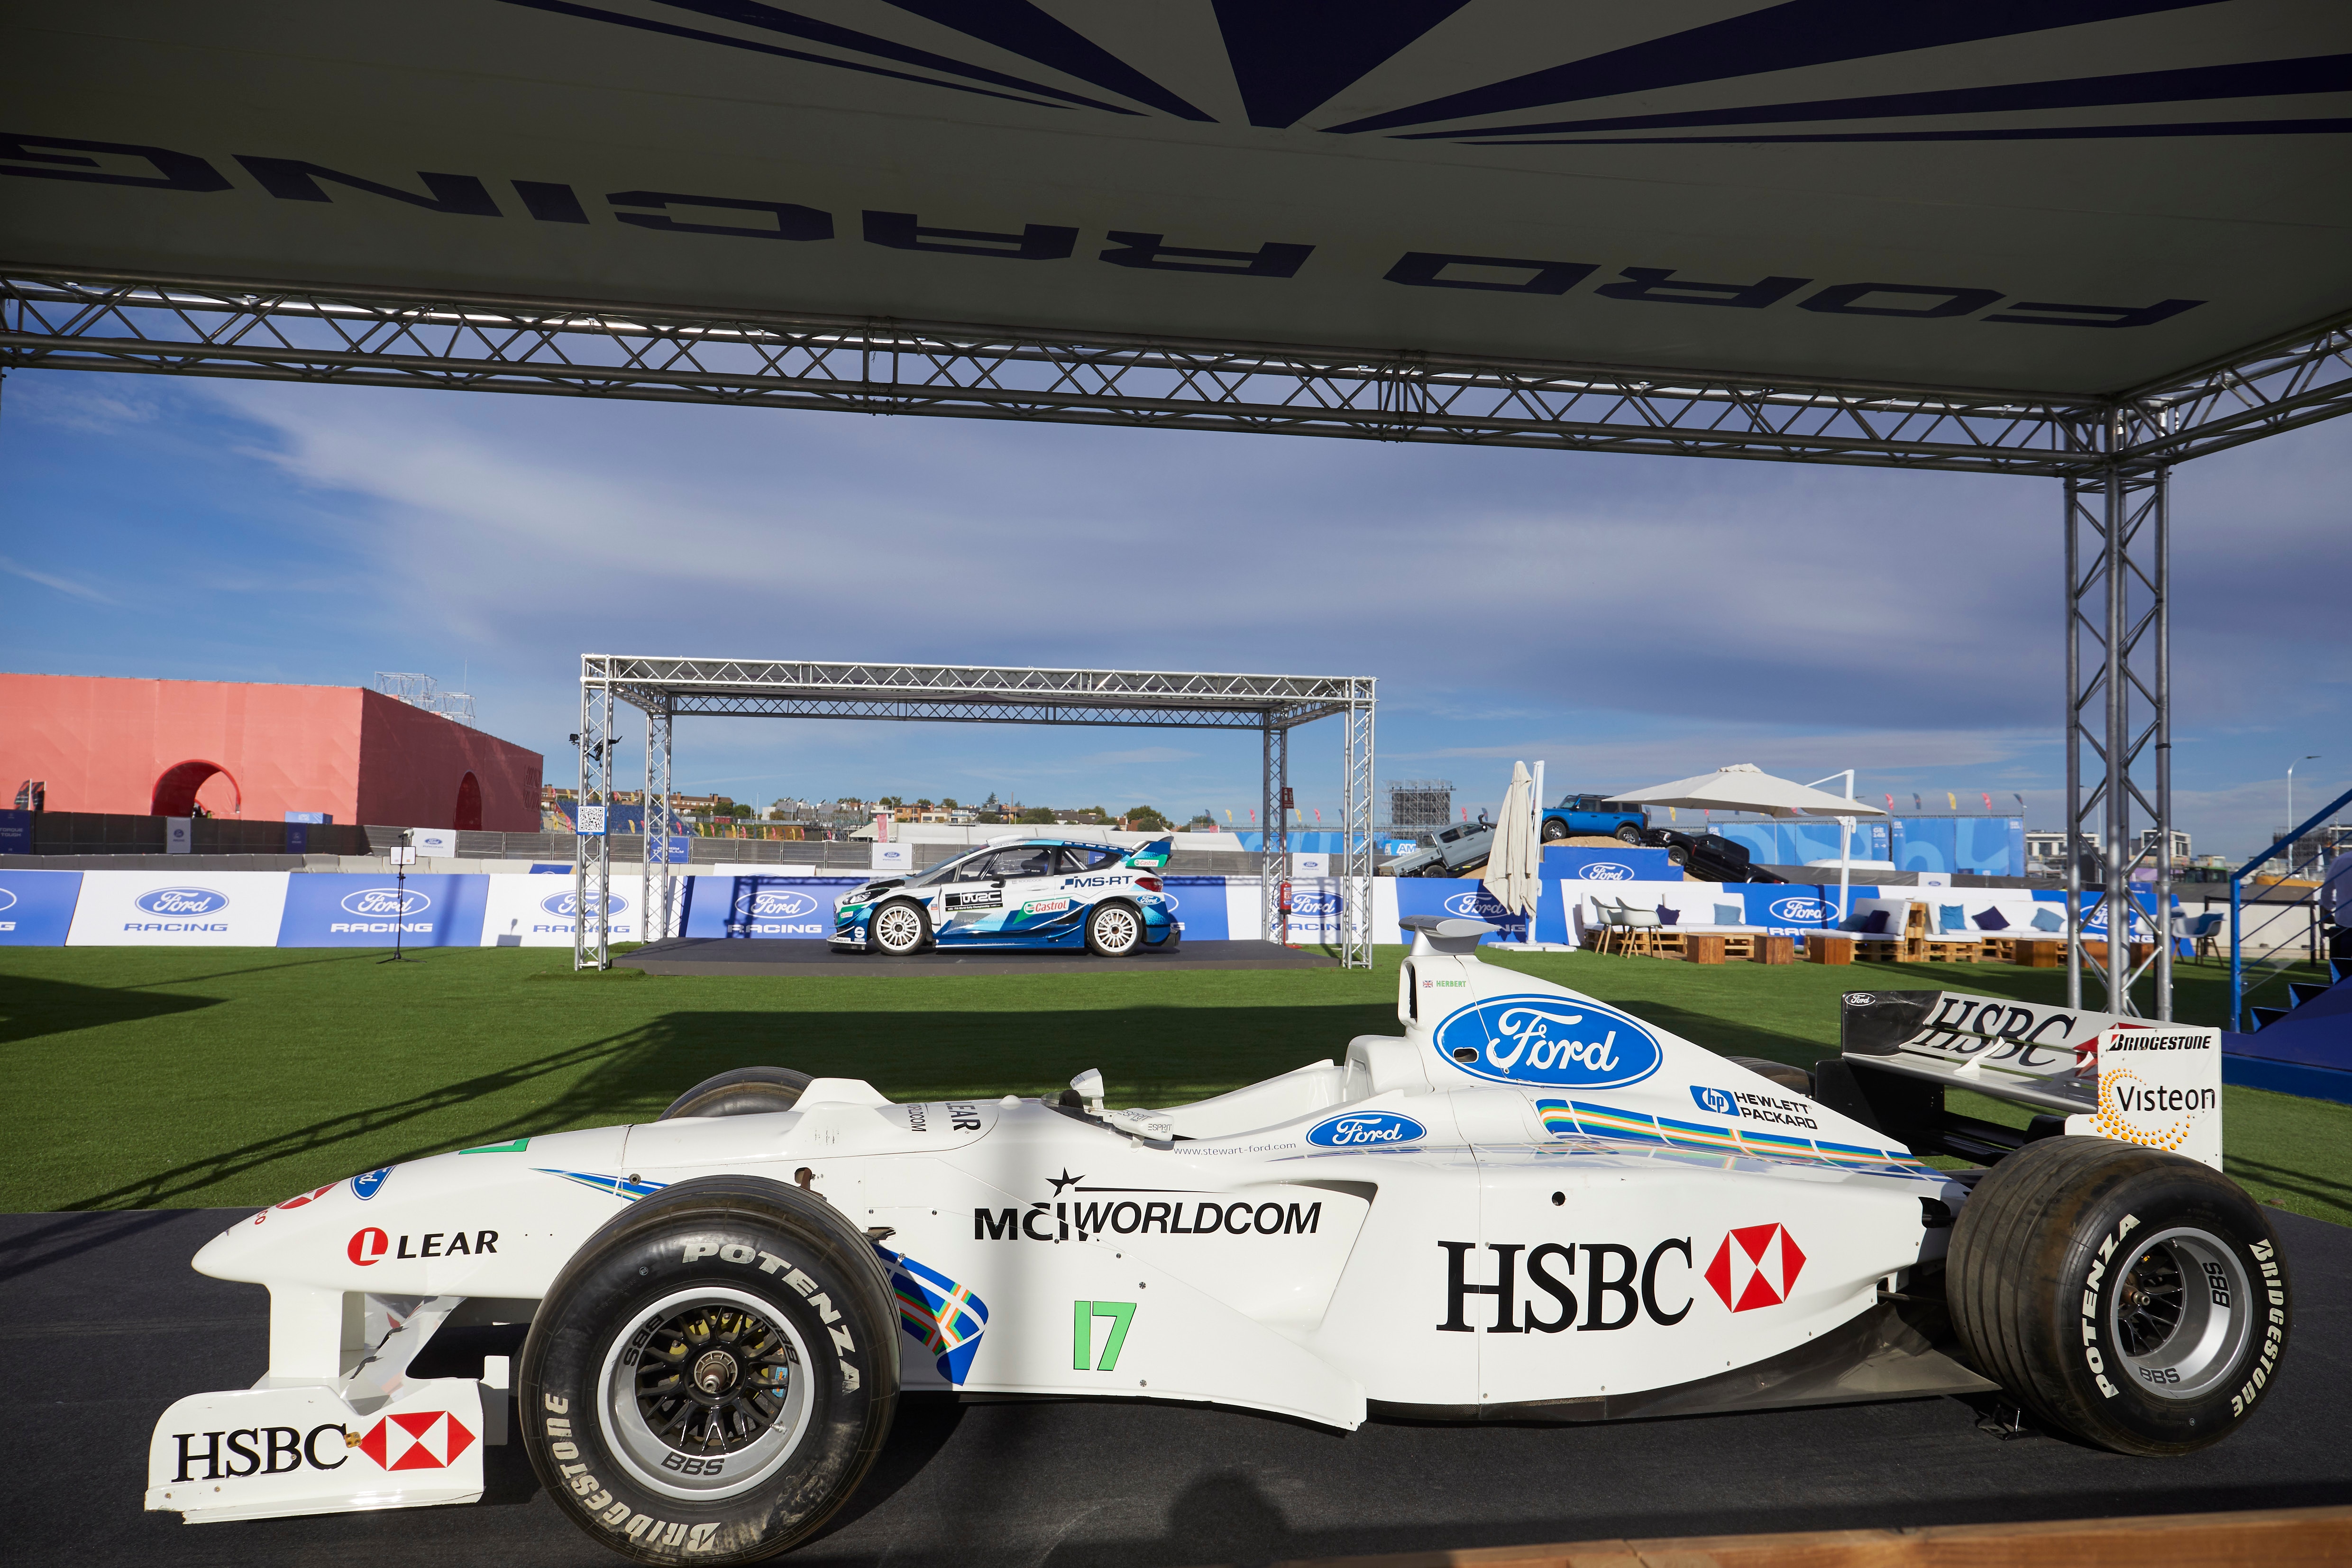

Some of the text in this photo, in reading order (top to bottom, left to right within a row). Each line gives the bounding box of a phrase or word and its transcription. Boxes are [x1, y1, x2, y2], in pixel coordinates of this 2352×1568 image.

[0, 133, 2207, 329] FORD RACING
[1074, 876, 1133, 888] MS-RT
[1589, 865, 1624, 880] Ford
[153, 891, 211, 912] Ford
[358, 892, 414, 912] Ford
[750, 894, 802, 914] Ford
[962, 891, 1001, 903] WRC
[1035, 901, 1067, 912] Castrol
[1140, 895, 1158, 903] Ford
[1291, 894, 1335, 913] Ford
[1459, 895, 1503, 914] Ford
[1784, 901, 1825, 919] Ford
[330, 923, 433, 932] RACING
[728, 924, 822, 933] RACING
[1486, 1007, 1619, 1071] Ford
[1912, 998, 2077, 1067] HSBC
[2108, 1034, 2212, 1051] BRIDGESTONE
[1708, 1088, 1724, 1113] hp
[1734, 1091, 1810, 1114] HEWLETT
[2116, 1085, 2216, 1112] Visteon
[945, 1102, 981, 1131] LEAR
[1117, 1110, 1153, 1121] ESPRIT
[1740, 1107, 1818, 1130] PACKARD
[1333, 1118, 1403, 1145] Ford
[1173, 1141, 1297, 1156] www.stewart-ford.com
[397, 1230, 499, 1259] LEAR
[1436, 1236, 1694, 1334] HSBC
[2202, 1262, 2230, 1308] BBS
[2082, 1213, 2141, 1399] POTENZA
[683, 1242, 860, 1396] POTENZA
[2231, 1238, 2284, 1418] BRIDGESTONE
[623, 1313, 665, 1367] BBS
[761, 1313, 800, 1366] BBS
[1073, 1300, 1137, 1371] 17
[2139, 1366, 2181, 1384] BBS
[171, 1423, 348, 1483] HSBC
[661, 1451, 724, 1476] BBS
[545, 1393, 721, 1552] BRIDGESTONE
